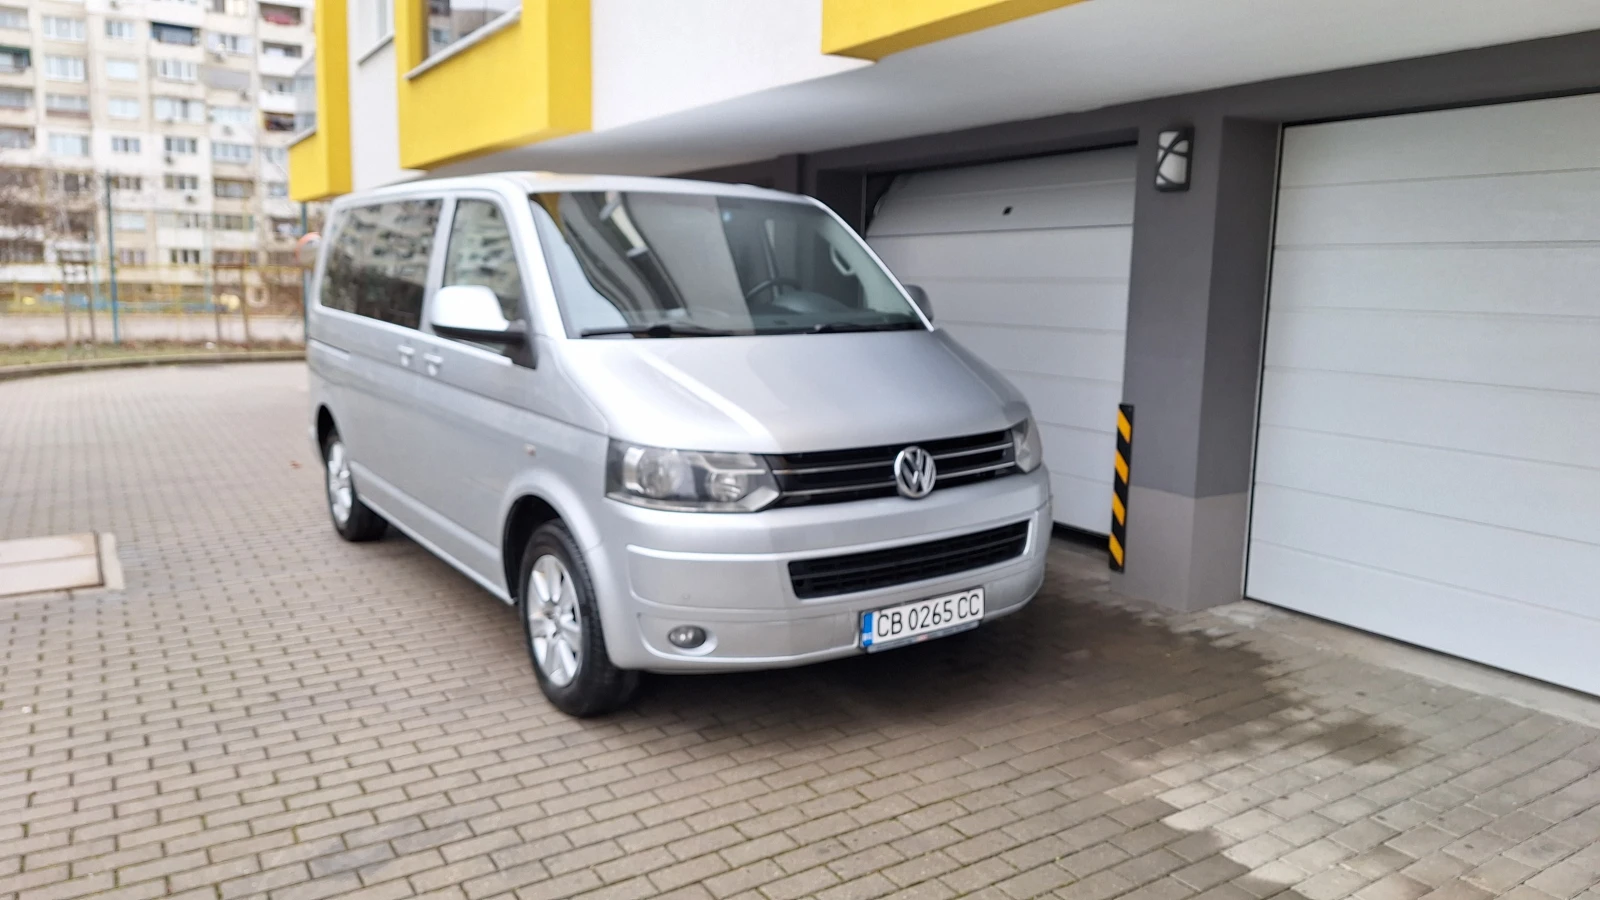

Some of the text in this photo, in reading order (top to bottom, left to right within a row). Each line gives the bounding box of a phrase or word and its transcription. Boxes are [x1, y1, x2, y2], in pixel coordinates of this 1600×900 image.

[877, 611, 903, 637] CB
[908, 600, 953, 630] 0265
[957, 594, 980, 619] CC
